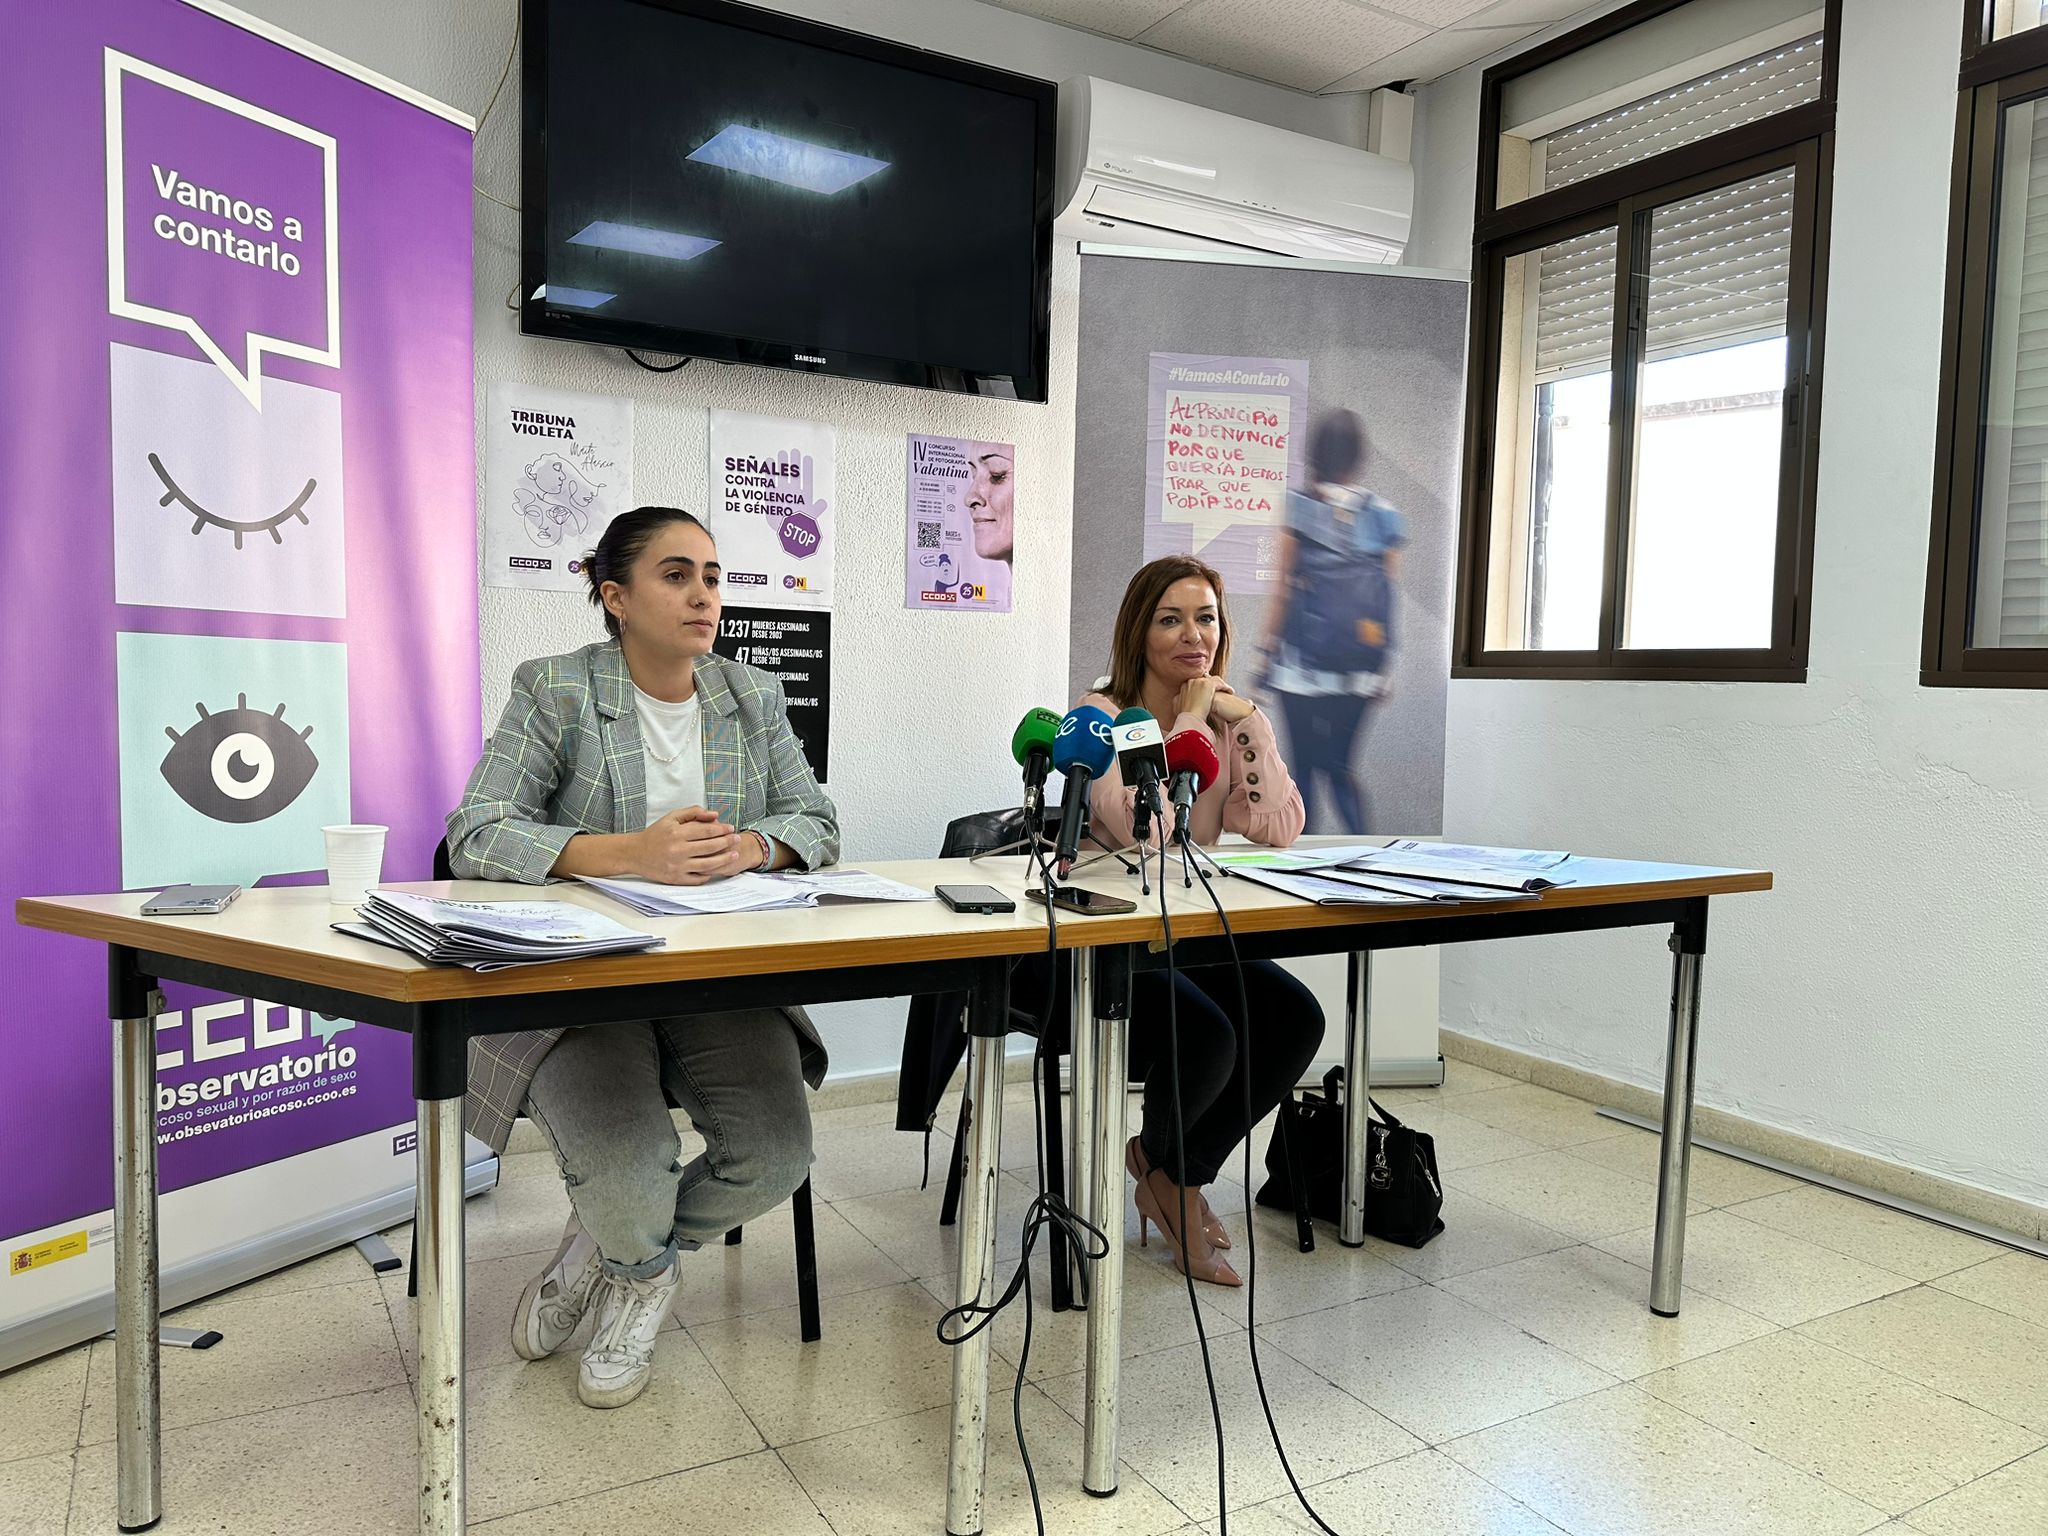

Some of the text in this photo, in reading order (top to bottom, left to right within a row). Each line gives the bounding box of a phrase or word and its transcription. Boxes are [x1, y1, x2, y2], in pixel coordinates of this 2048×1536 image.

[151, 163, 303, 242] Vamos a
[154, 214, 300, 276] contarlo
[794, 354, 827, 364] SAMSUNG
[1169, 367, 1290, 387] #VamosAContarlo
[1169, 396, 1194, 421] AL
[511, 410, 576, 428] TRIBUNA
[512, 422, 574, 440] VIOLETA
[1169, 423, 1193, 437] NO
[914, 440, 956, 461] IV CONCURSO
[725, 455, 801, 478] SEÑALES
[914, 462, 969, 479] Valentina
[725, 474, 776, 489] CONTRA
[1218, 481, 1252, 493] QUE
[725, 487, 805, 505] LA VIOLENCIA
[725, 501, 793, 517] DE GÉNERO
[783, 522, 816, 547] STOP
[720, 619, 810, 638] 1.237 MUJERES ASESINADAS
[752, 630, 769, 639] DESDE
[735, 647, 750, 664] 47
[752, 656, 768, 664] DESDE
[157, 1043, 357, 1111] bservatorio
[196, 1097, 239, 1118] sexual
[242, 1097, 250, 1108] y
[252, 1090, 274, 1106] por
[276, 1080, 310, 1098] razón
[313, 1075, 327, 1089] de
[330, 1069, 357, 1085] sexo
[157, 1085, 357, 1145] w.obsevatorioacoso.ccoo.es
